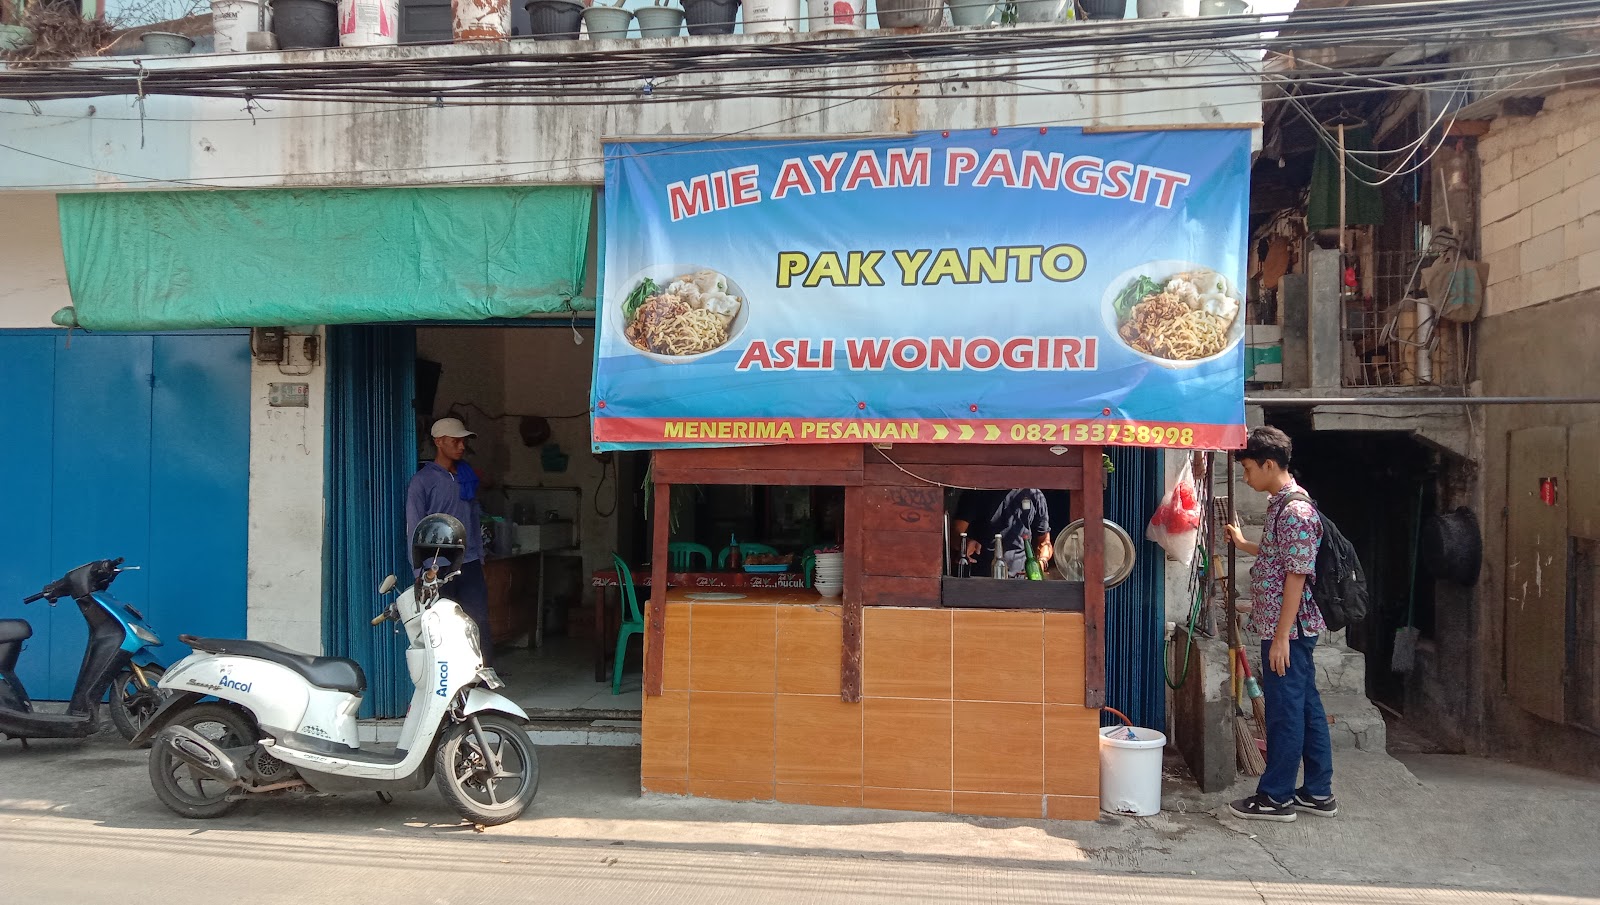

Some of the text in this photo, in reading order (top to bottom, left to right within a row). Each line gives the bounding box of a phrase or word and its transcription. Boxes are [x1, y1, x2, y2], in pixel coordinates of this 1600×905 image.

[666, 146, 1190, 223] MIE AYAM PANGSIT
[776, 243, 1087, 289] PAK YANTO
[737, 337, 1098, 373] ASLI WONOGIRI
[664, 421, 1194, 445] MENERIMA PESANAN 082133738998
[218, 675, 252, 693] Ancol
[436, 661, 449, 697] Ancol
